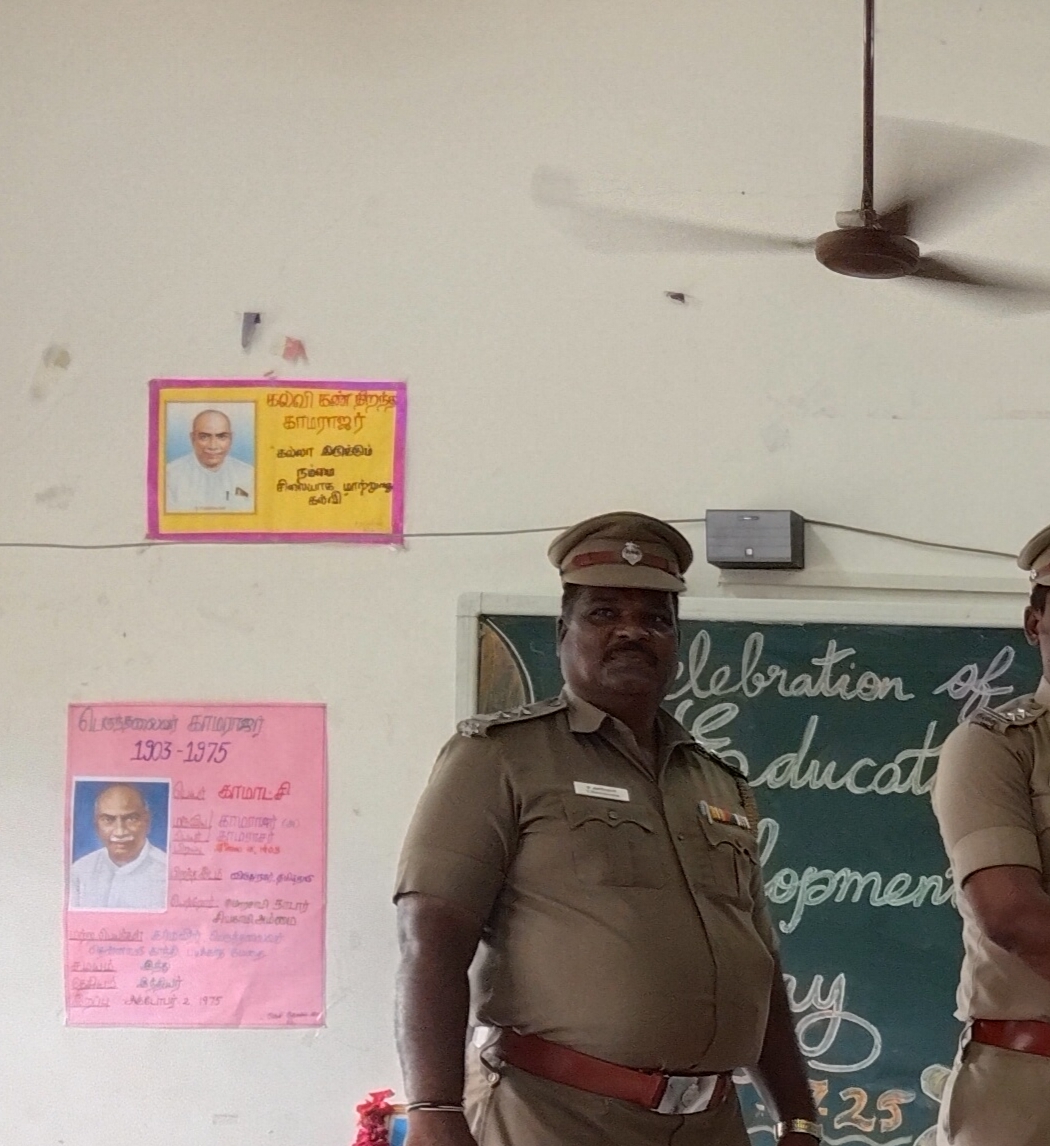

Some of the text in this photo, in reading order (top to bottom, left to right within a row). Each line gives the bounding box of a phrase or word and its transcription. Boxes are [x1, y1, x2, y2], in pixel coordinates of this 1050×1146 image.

[283, 412, 366, 435] காமராஜர்
[665, 630, 1015, 725] lebration of
[674, 698, 946, 796] Educat
[218, 781, 291, 800] காமாட்சி
